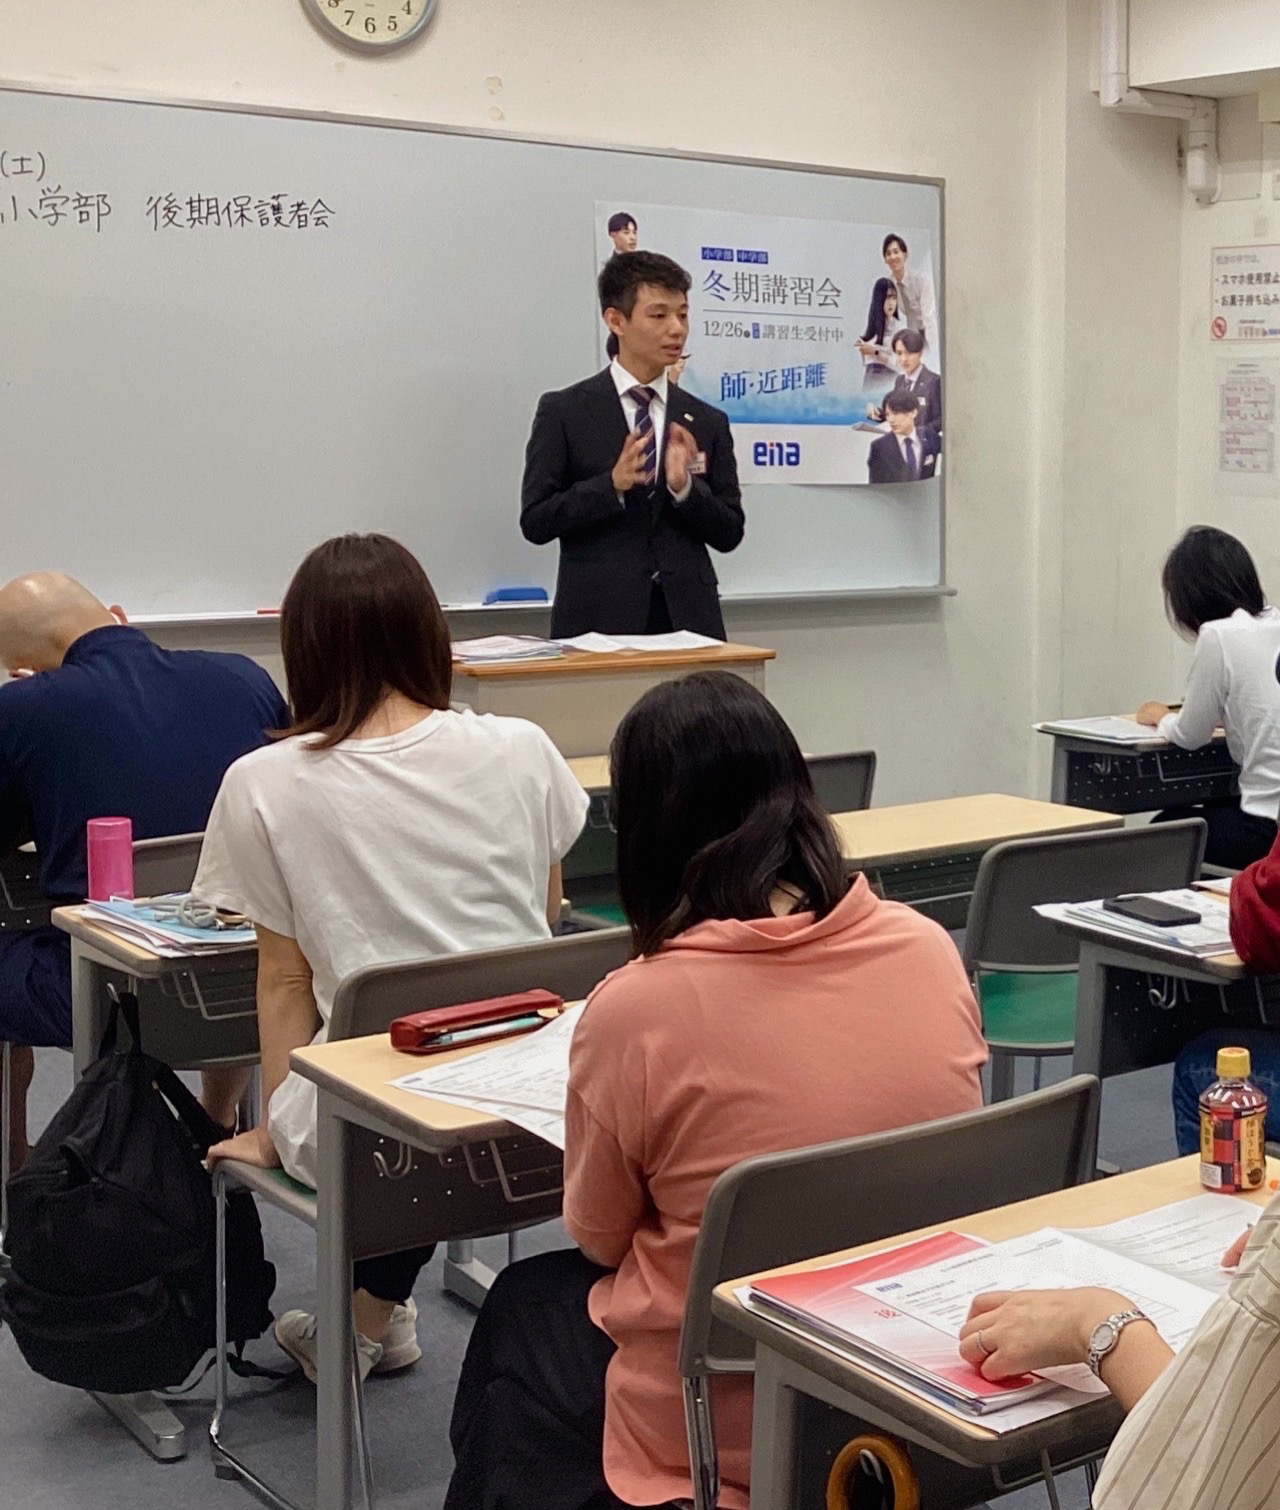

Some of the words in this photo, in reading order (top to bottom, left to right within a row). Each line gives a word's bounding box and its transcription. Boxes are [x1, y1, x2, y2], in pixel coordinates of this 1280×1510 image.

[401, 0, 412, 15] 4
[344, 10, 355, 26] 7
[364, 17, 376, 34] 6
[387, 16, 398, 32] 5
[0, 185, 112, 233] 小学部
[146, 192, 336, 232] 後期保護者会
[703, 248, 734, 261] 小学部
[738, 250, 768, 264] 中学部
[702, 269, 843, 308] 冬期講習会
[703, 320, 744, 338] 12/26
[762, 324, 844, 342] 講習生受付中
[753, 441, 801, 466] ena
